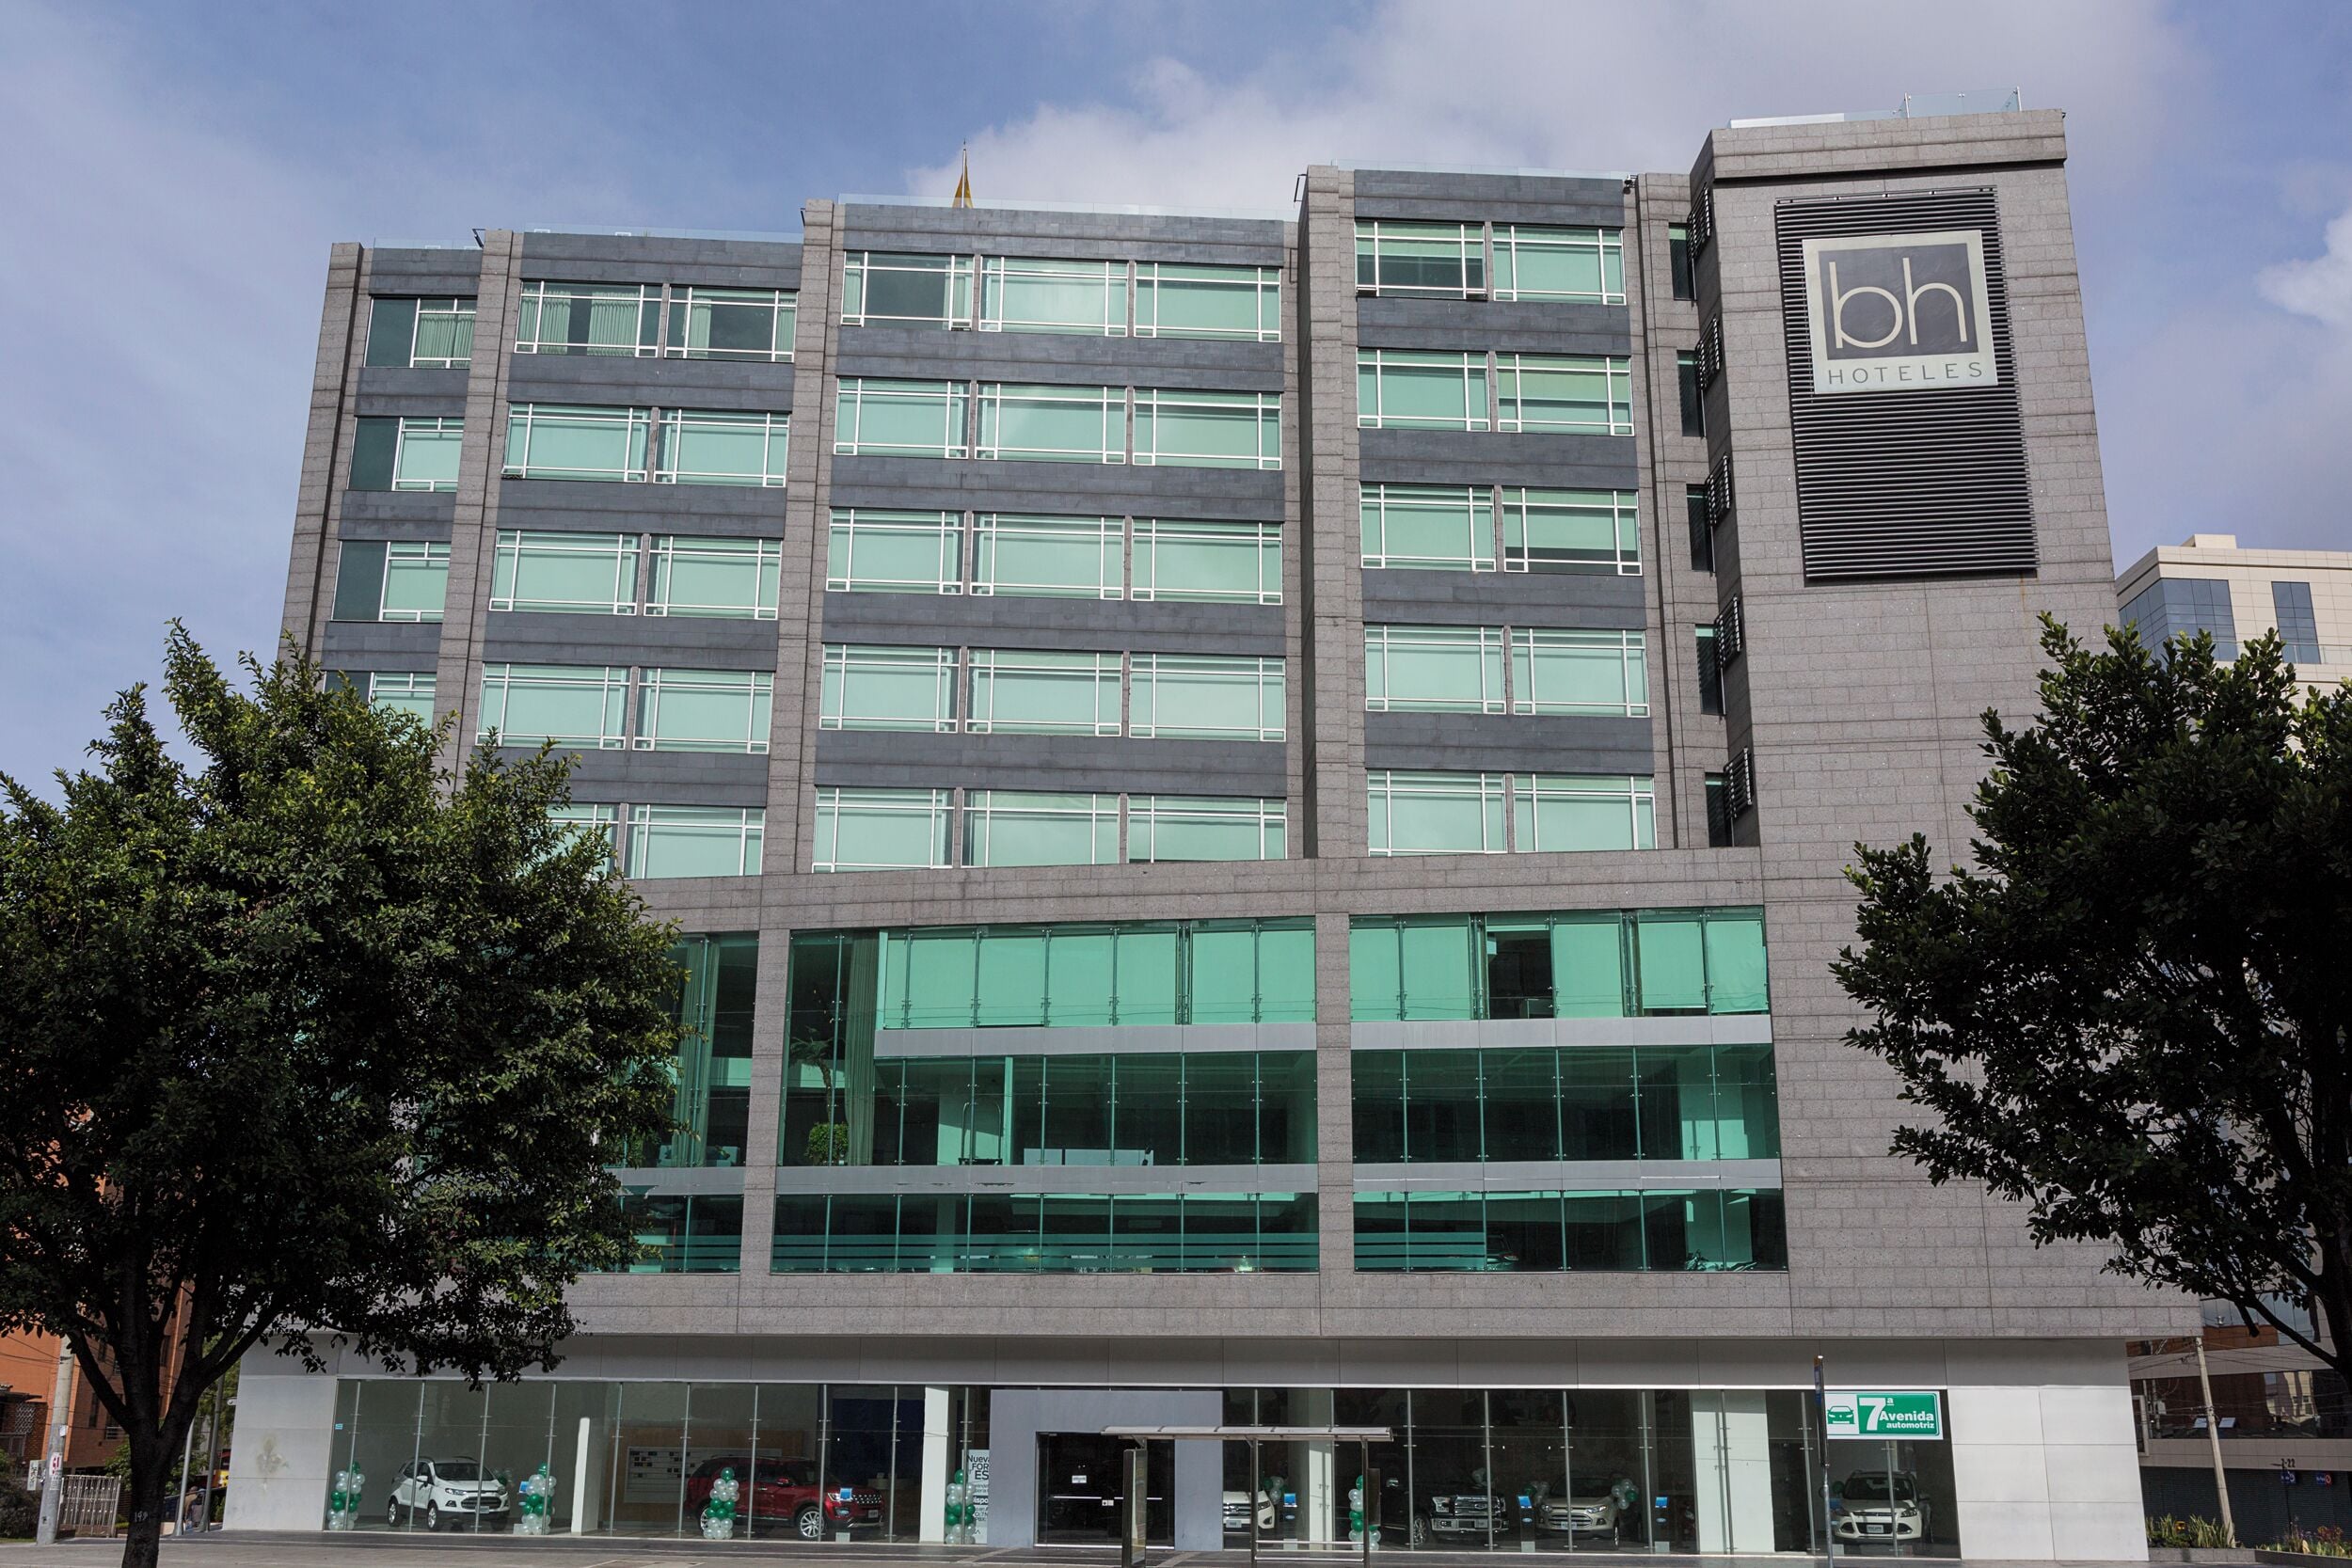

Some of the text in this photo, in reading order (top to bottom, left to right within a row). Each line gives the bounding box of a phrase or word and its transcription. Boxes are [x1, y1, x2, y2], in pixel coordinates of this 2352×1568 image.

[1828, 257, 1968, 349] bh
[1828, 361, 1983, 385] HOTELES
[1879, 1410, 1935, 1421] Avenida
[975, 1470, 990, 1481] ES
